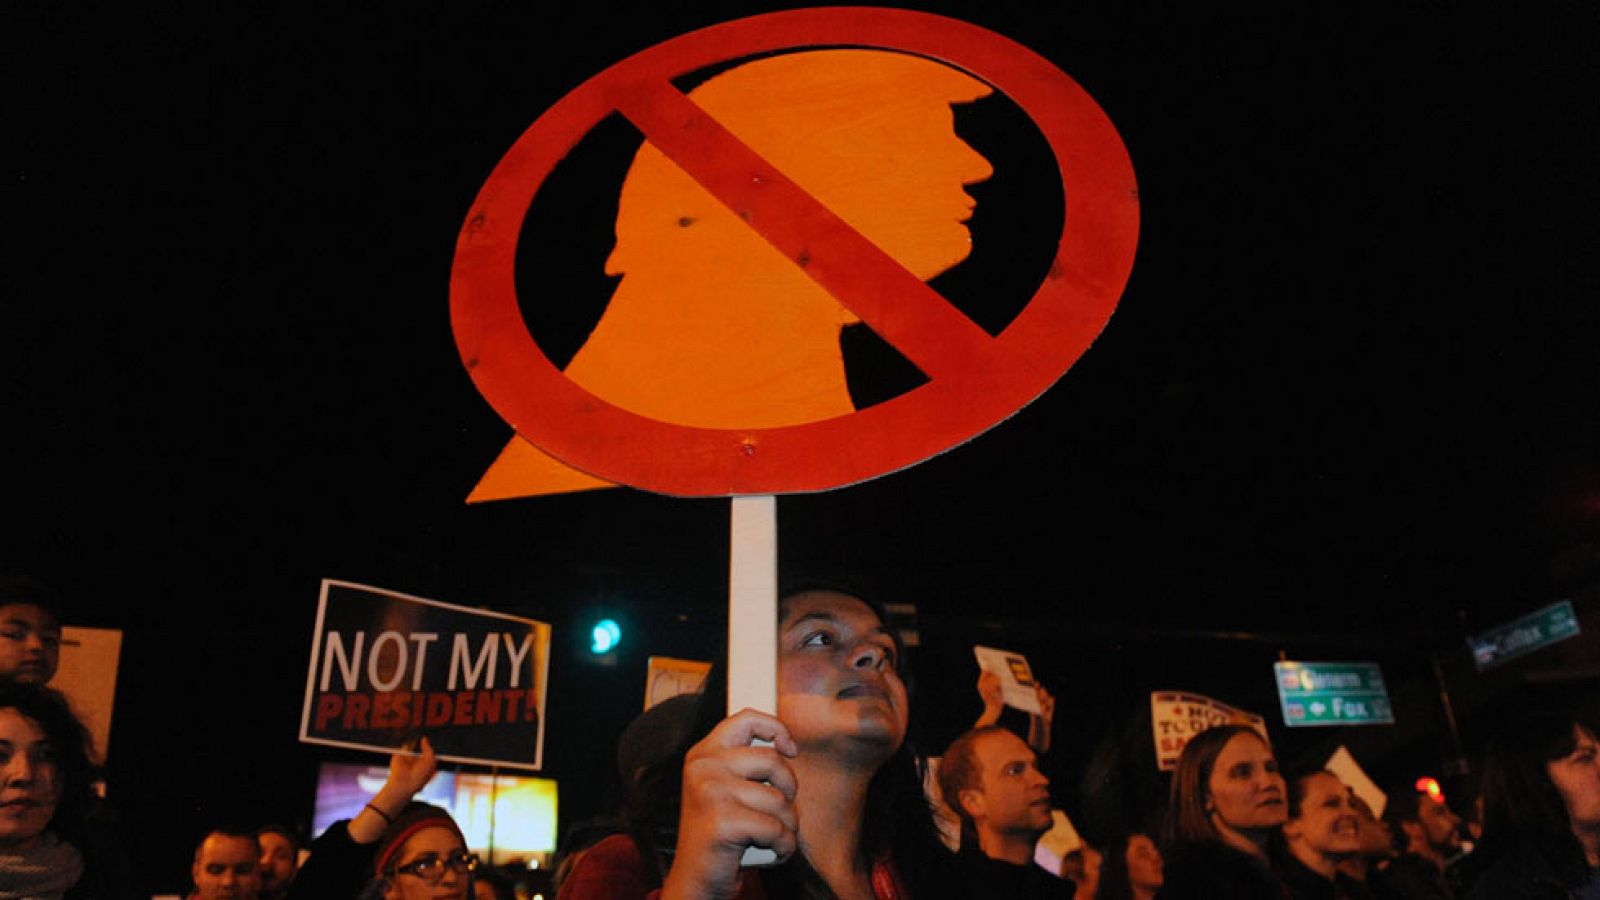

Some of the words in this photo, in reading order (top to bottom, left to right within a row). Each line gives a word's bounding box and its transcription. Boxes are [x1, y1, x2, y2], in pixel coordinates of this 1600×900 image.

[319, 630, 438, 692] NOT
[447, 632, 535, 691] MY
[315, 689, 538, 732] PRESIDENT!
[1332, 697, 1368, 717] Fox
